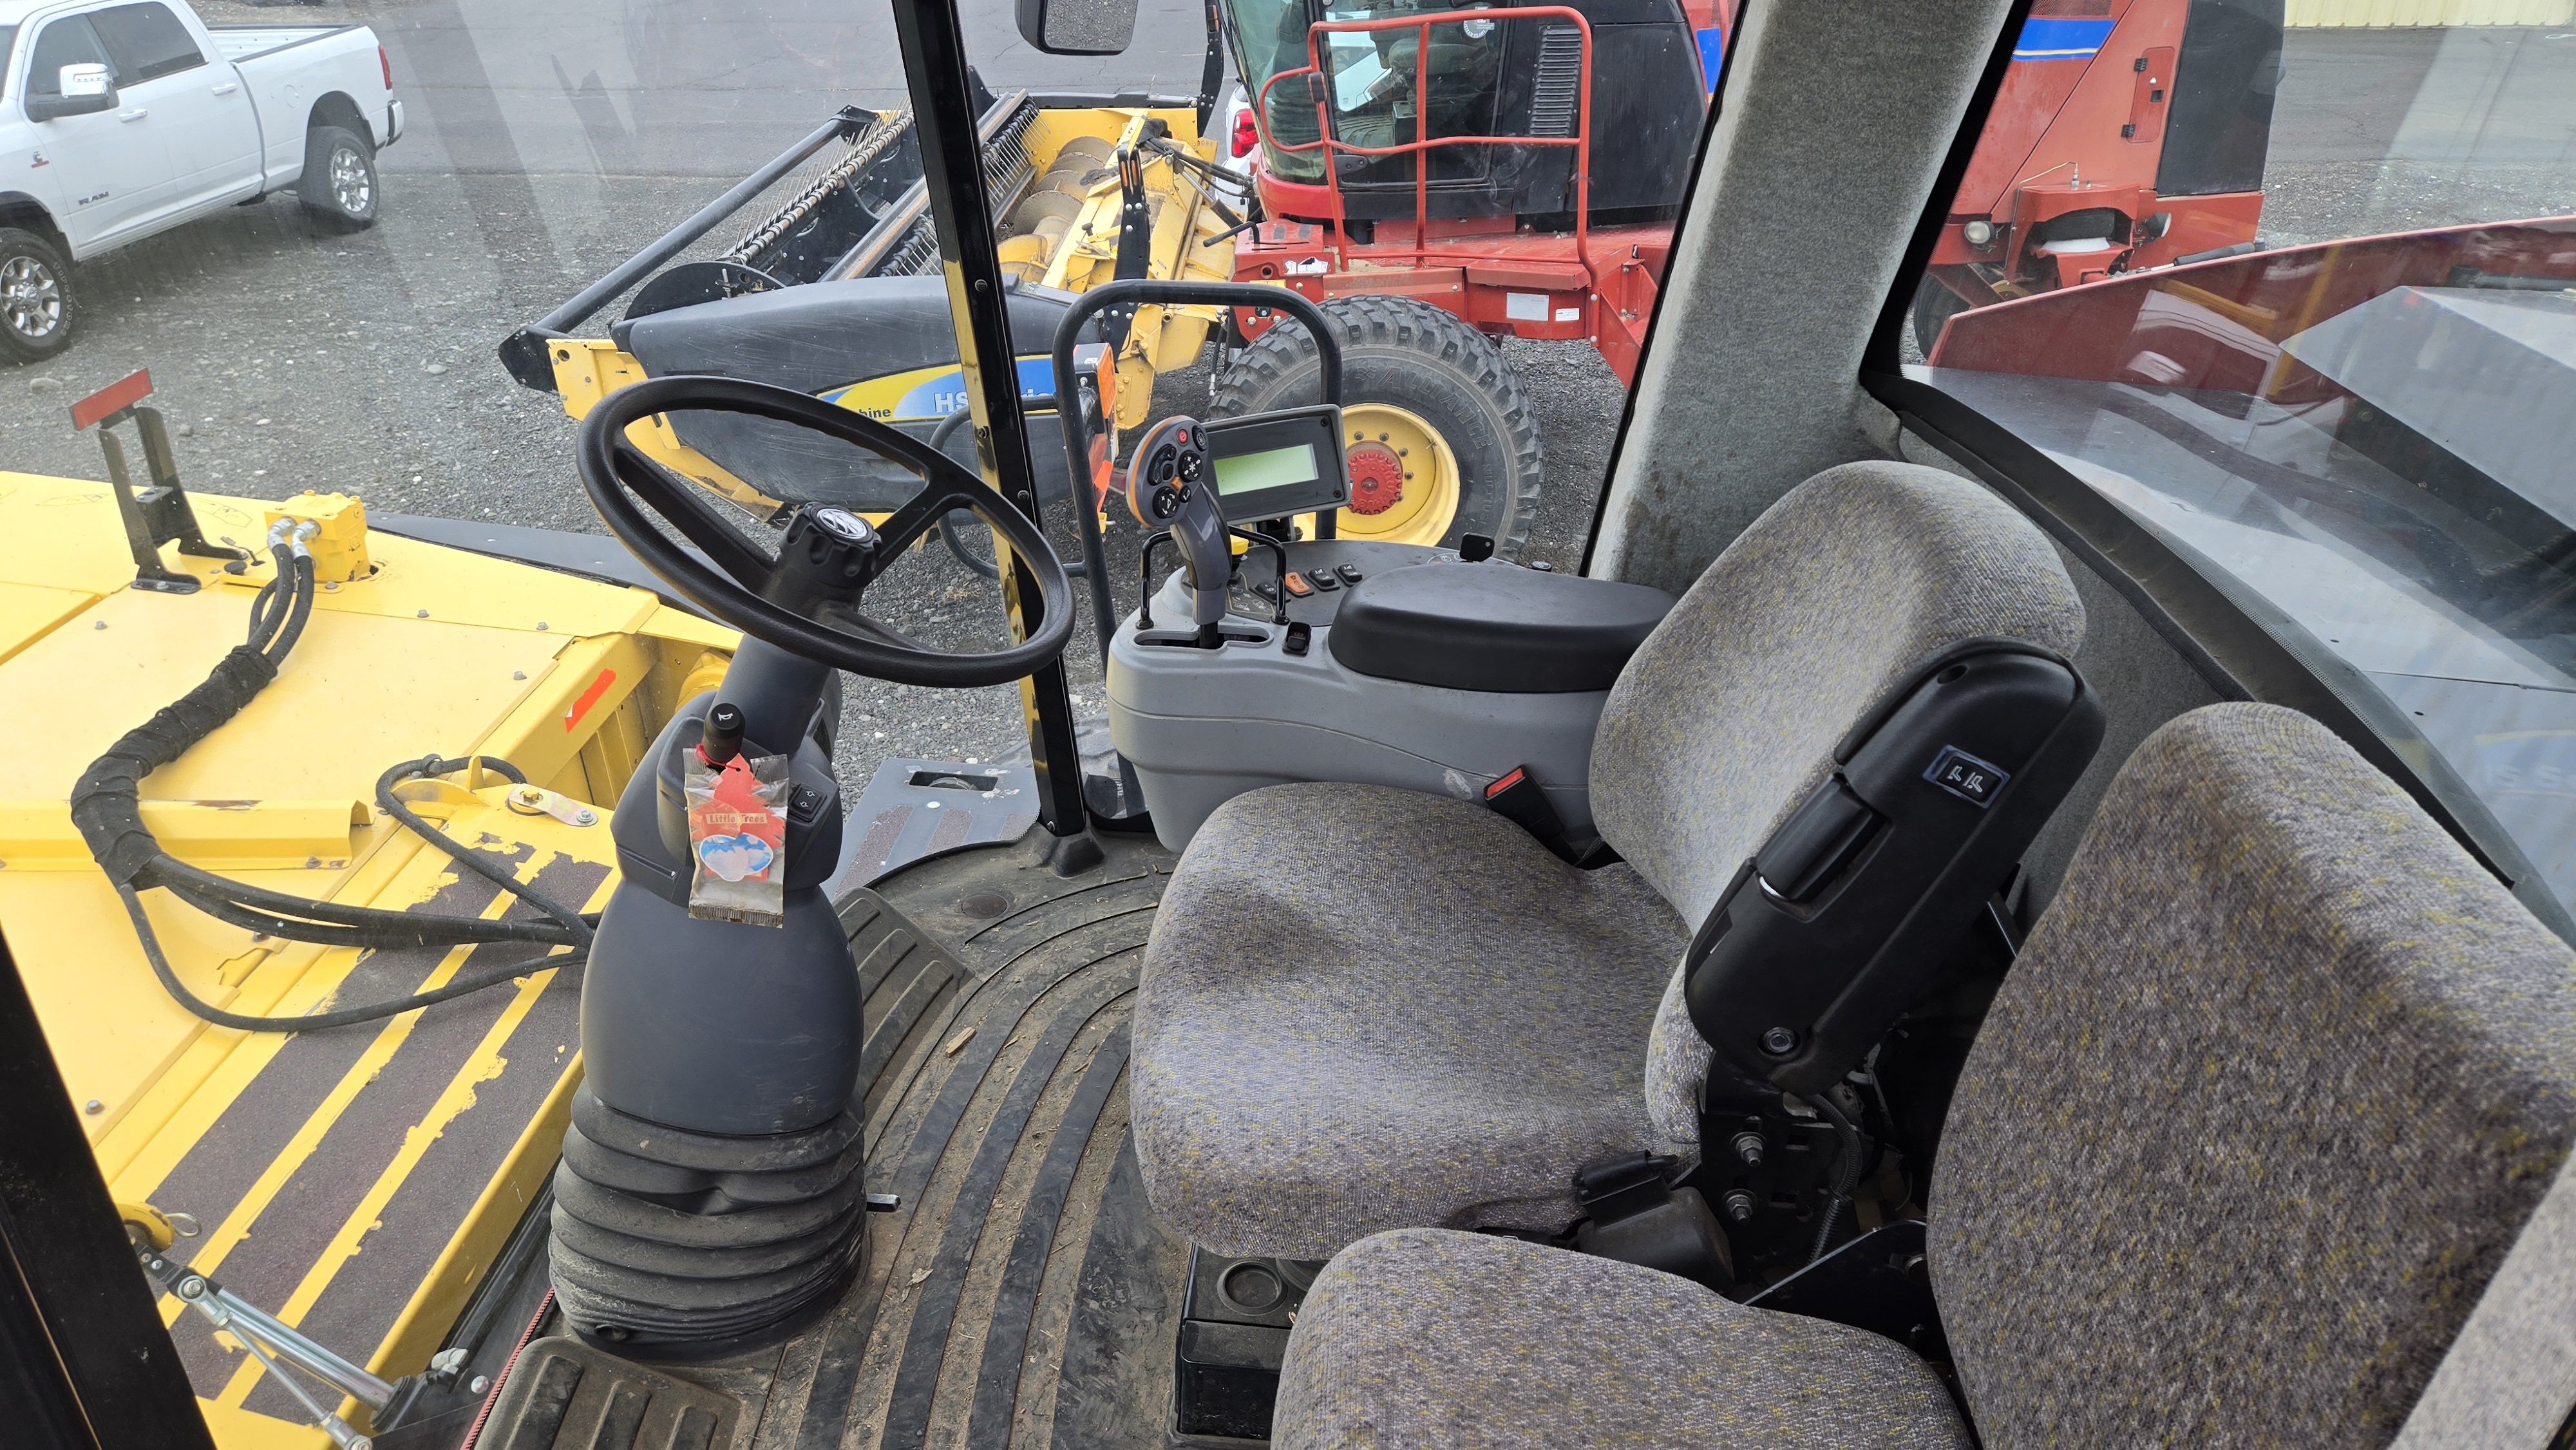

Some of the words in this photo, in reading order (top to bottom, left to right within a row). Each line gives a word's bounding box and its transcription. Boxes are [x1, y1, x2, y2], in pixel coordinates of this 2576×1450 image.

[79, 191, 109, 205] RAM
[1376, 366, 1493, 449] ALLIANCE
[710, 814, 735, 823] Little
[741, 814, 764, 823] Trees
